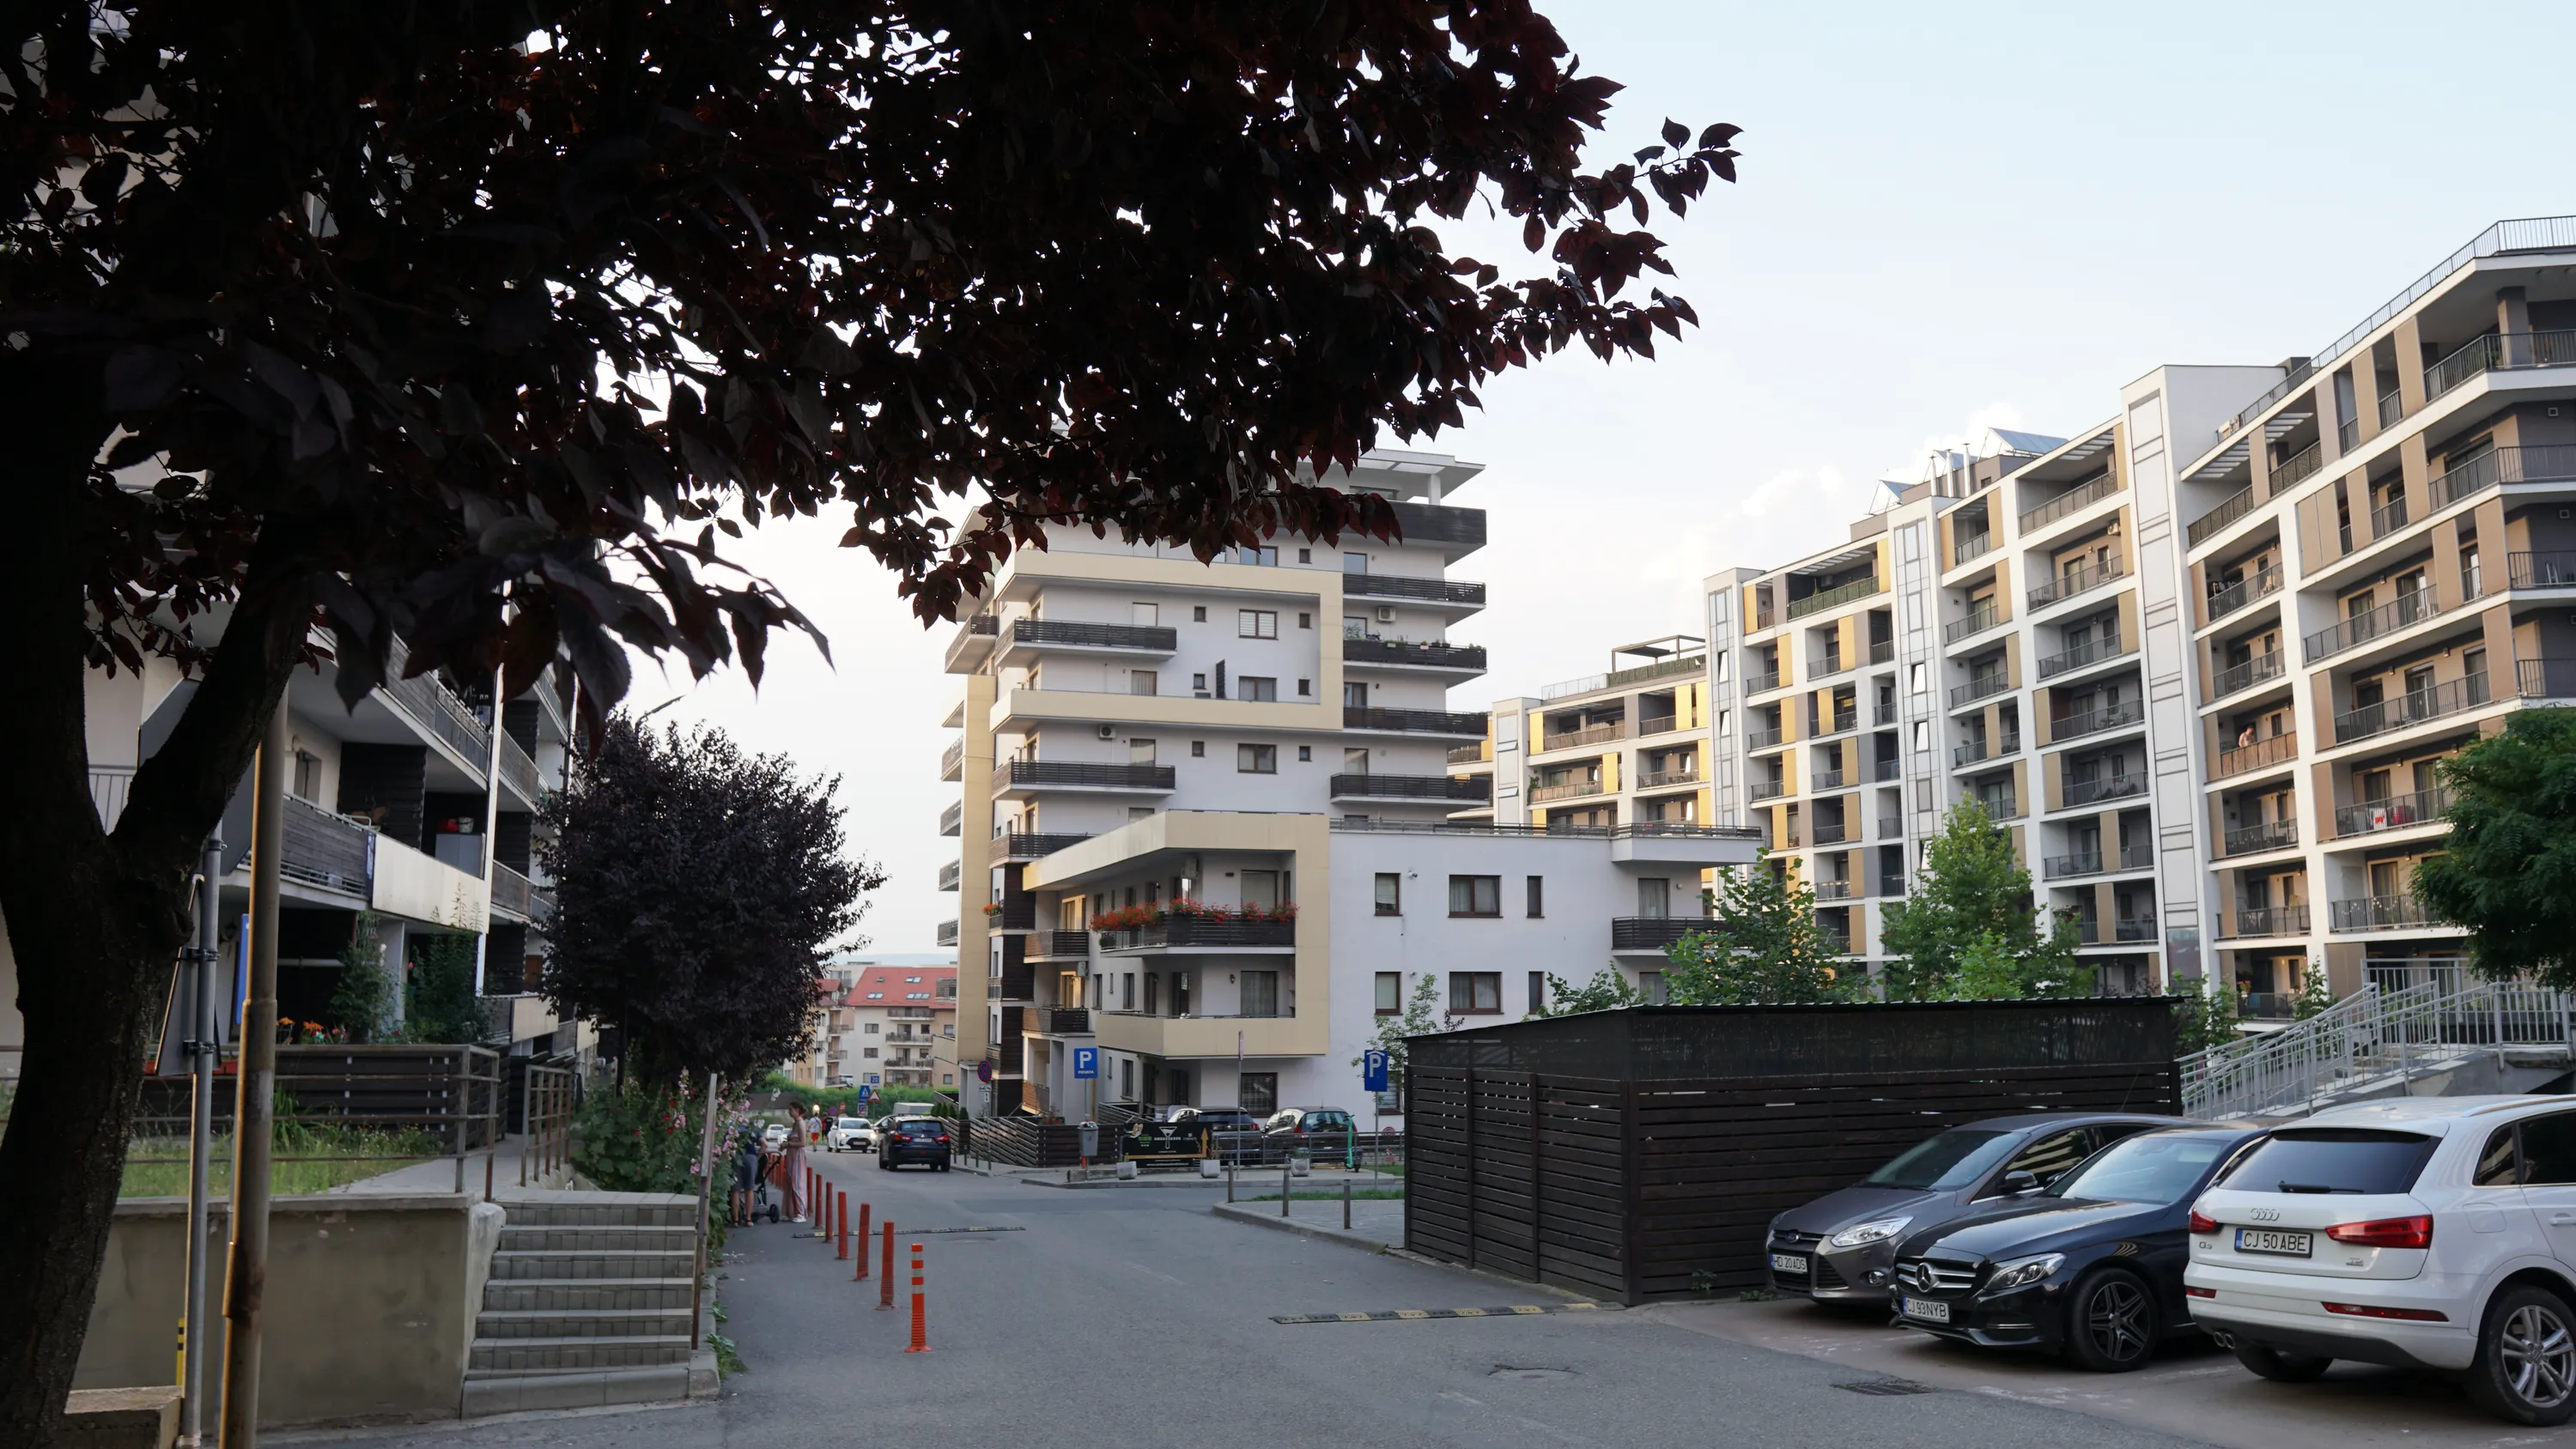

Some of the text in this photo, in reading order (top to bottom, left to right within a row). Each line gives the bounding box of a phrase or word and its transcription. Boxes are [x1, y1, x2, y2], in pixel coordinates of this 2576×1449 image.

[1079, 1051, 1092, 1069] P
[1370, 1054, 1382, 1077] P
[2244, 1232, 2307, 1252] CJ 50 ABE
